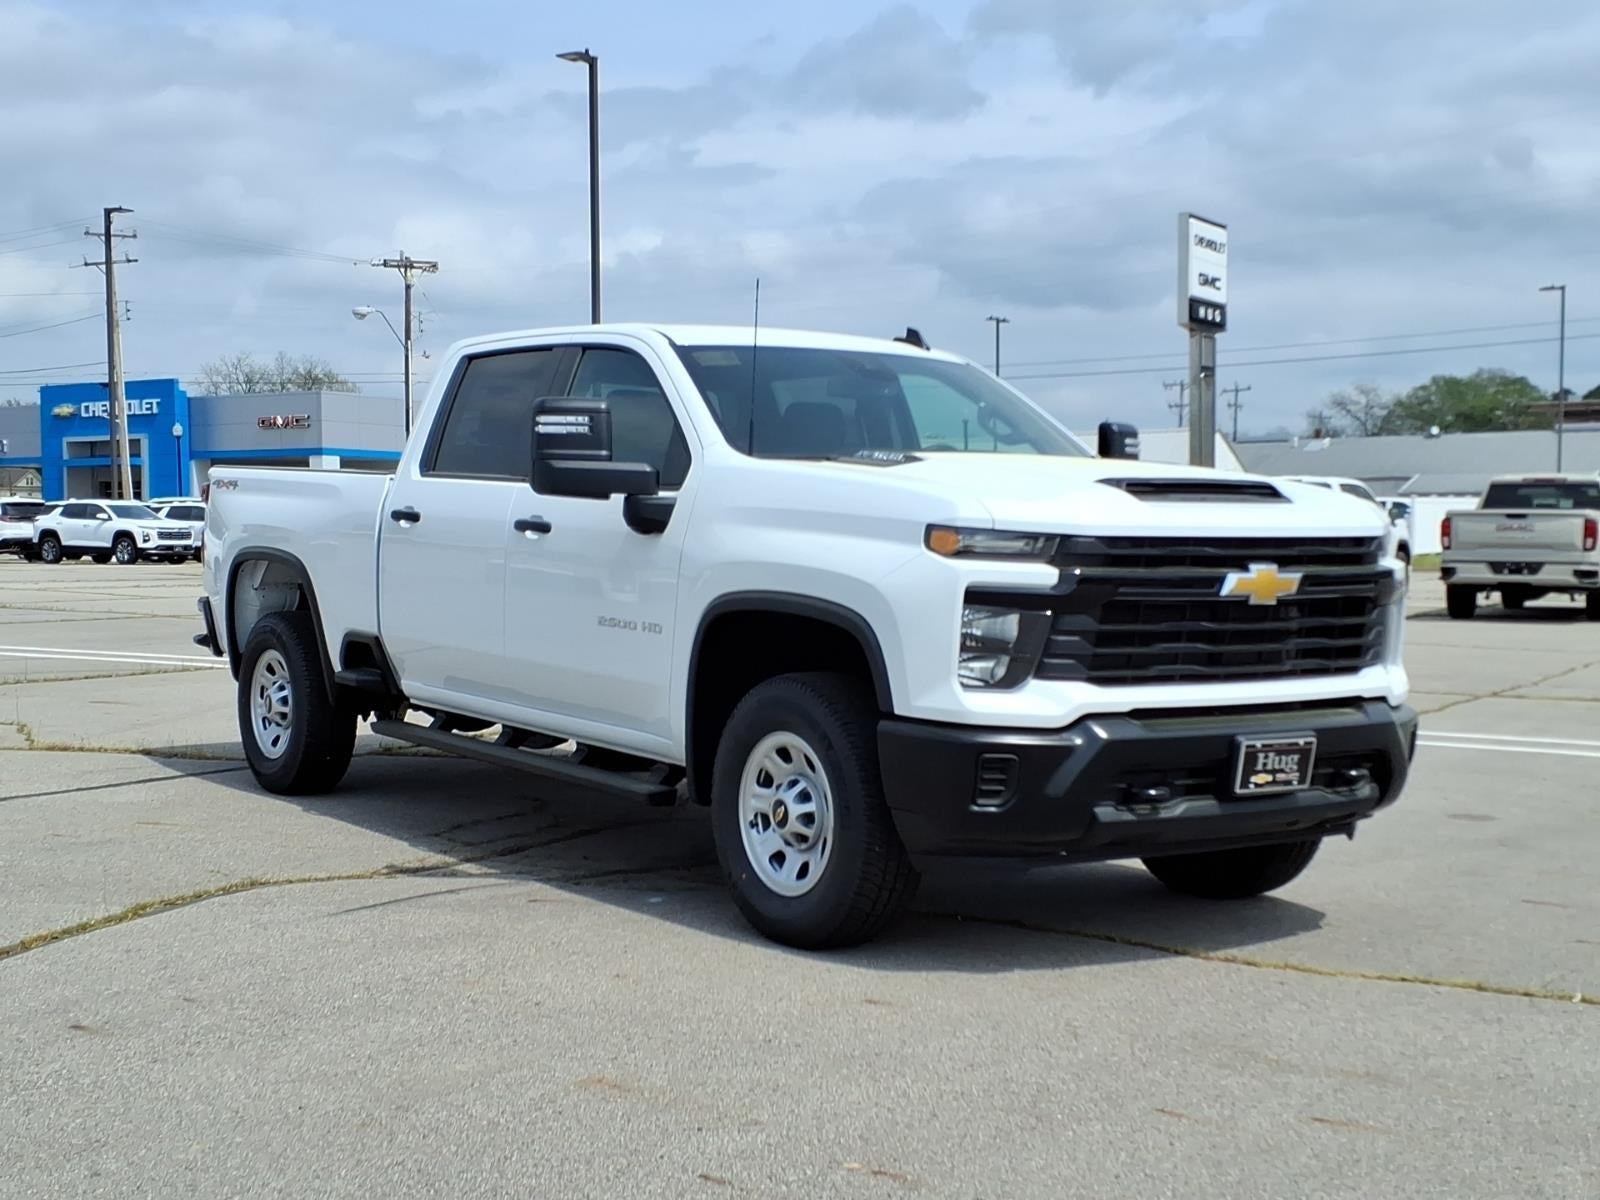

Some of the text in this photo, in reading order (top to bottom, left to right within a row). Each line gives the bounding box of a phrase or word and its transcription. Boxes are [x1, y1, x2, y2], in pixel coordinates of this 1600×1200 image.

[80, 399, 161, 418] CHEOLET
[257, 414, 311, 429] GMC
[597, 615, 663, 634] 2500 HD
[1254, 752, 1301, 773] Hug
